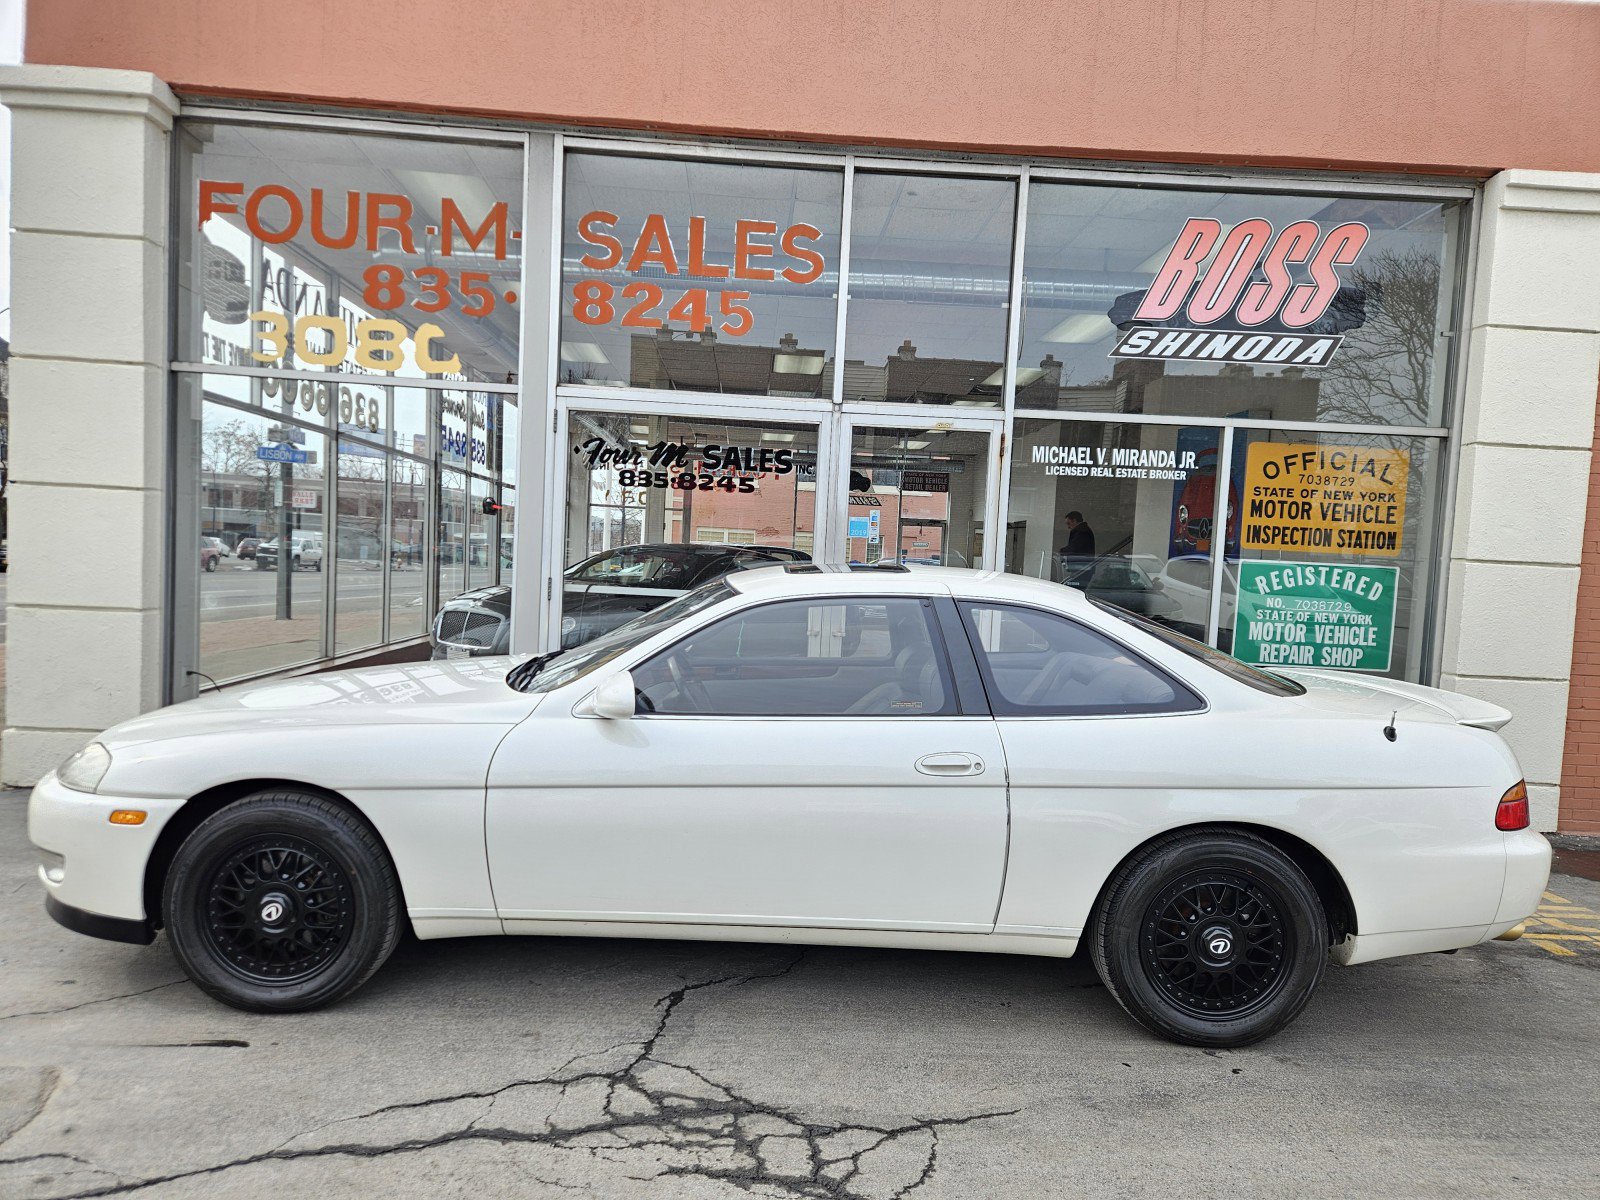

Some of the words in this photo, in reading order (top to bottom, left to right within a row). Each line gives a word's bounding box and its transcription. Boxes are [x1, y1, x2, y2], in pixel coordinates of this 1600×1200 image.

[577, 210, 825, 284] SALES
[1132, 217, 1370, 328] BOSS
[572, 280, 754, 336] 8245
[1119, 330, 1333, 364] SHINODA
[260, 448, 292, 461] LISBON
[582, 437, 643, 466] Four
[646, 440, 689, 467] M
[702, 444, 793, 474] SALES
[1032, 445, 1094, 465] MICHAEL
[1097, 447, 1108, 465] V.
[1112, 448, 1176, 468] MIRANDA
[1179, 451, 1199, 470] JR.
[1045, 465, 1089, 477] LICENSED
[1090, 467, 1114, 478] REAL
[1116, 468, 1147, 479] ESTATE
[1150, 470, 1187, 481] BROKER
[1263, 451, 1393, 486] OFFICIAL
[1299, 474, 1355, 487] 7038729
[1253, 486, 1295, 498] STATE
[1300, 489, 1318, 499] OF
[1323, 490, 1354, 501] NEW
[1360, 491, 1396, 503] YORK
[1250, 499, 1312, 520] MOTOR
[1320, 502, 1397, 524] VEHICLE
[1246, 525, 1333, 547] INSPECTION
[1336, 529, 1397, 550] STATION
[1255, 566, 1383, 601] REGISTERED
[1266, 597, 1286, 609] NO.
[1295, 600, 1352, 611] 7038729
[1256, 609, 1293, 621] STATE
[1296, 611, 1310, 622] OF
[1314, 612, 1339, 624] NEW
[1343, 613, 1373, 625] YORK
[1248, 621, 1307, 643] MOTOR
[1315, 624, 1378, 646] VEHICLE
[1260, 643, 1315, 665] REPAIR
[1321, 646, 1364, 667] SHOP
